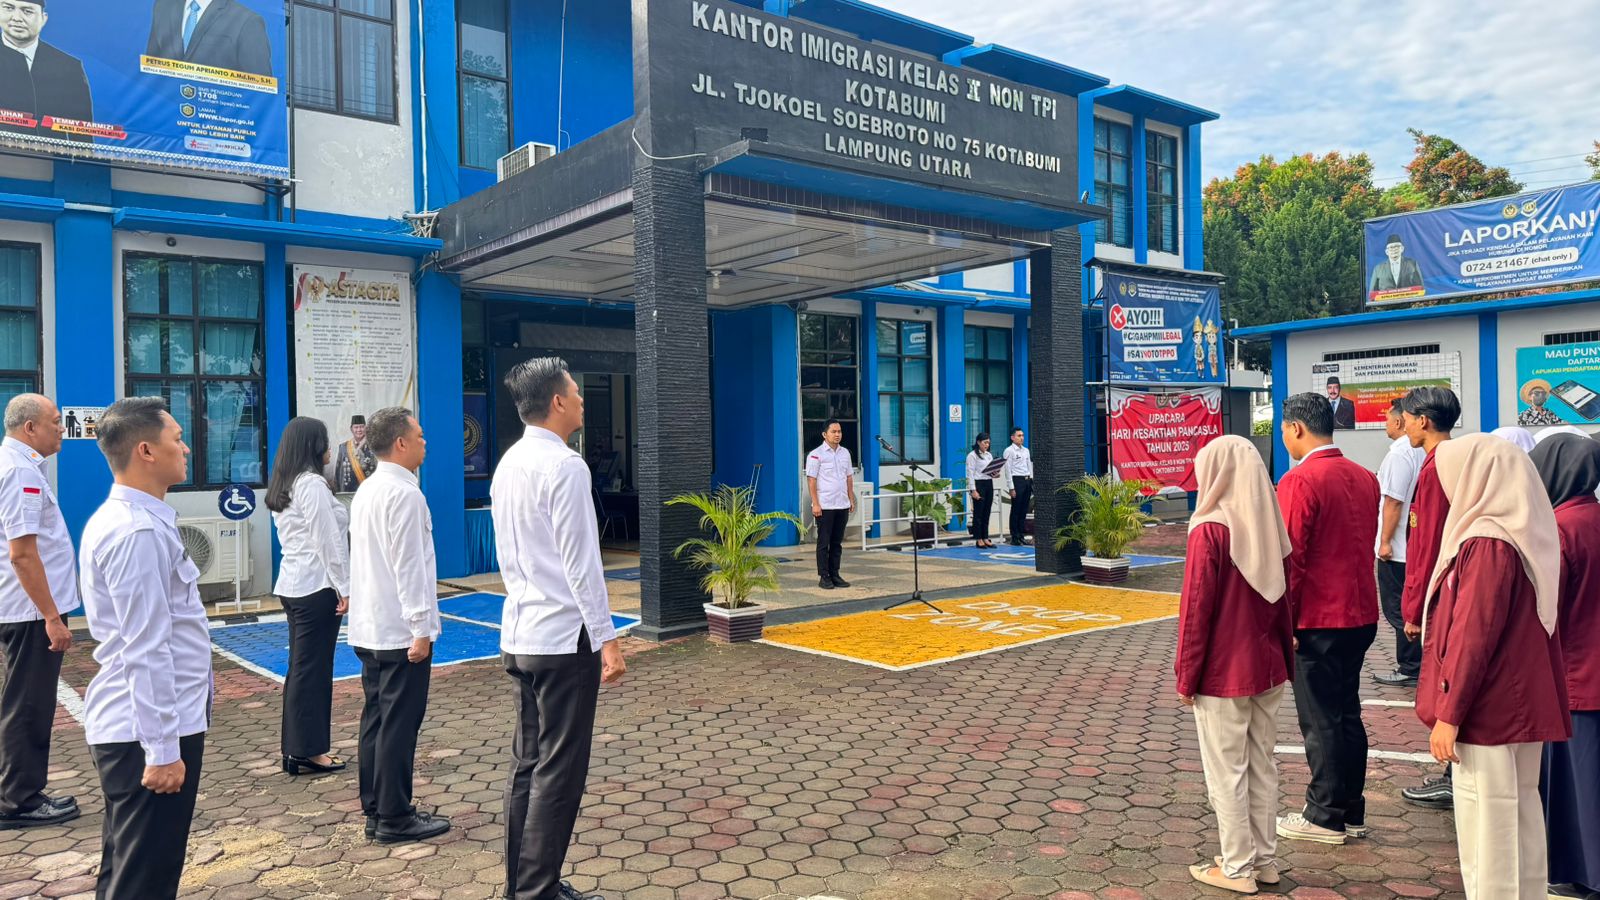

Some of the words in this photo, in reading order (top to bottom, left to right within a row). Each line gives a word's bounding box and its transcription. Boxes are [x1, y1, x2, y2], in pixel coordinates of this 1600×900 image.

[146, 58, 170, 66] PETRUS
[172, 62, 194, 71] TEGUH
[196, 65, 229, 76] APRIANTO
[692, 1, 794, 54] KANTOR
[801, 32, 894, 80] IMIGRASI
[899, 60, 959, 97] KELAS
[989, 83, 1024, 112] NON
[1030, 94, 1057, 120] TPI
[198, 92, 218, 100] 1708
[844, 79, 946, 124] KOTABUMI
[52, 117, 80, 126] TEMMY
[82, 121, 114, 130] TARMIZI
[202, 124, 232, 133] LAYANAN
[234, 128, 256, 136] PUBLIK
[691, 74, 726, 100] JL.
[734, 82, 827, 123] TJOKOEL
[832, 107, 929, 145] SOEBROTO
[933, 131, 956, 152] NO
[962, 138, 981, 156] 75
[984, 144, 1061, 174] KOTABUMI
[210, 130, 228, 138] LEBIH
[824, 133, 912, 168] LAMPUNG
[919, 154, 972, 179] UTARA
[1444, 210, 1596, 248] LAPORKAN!
[1461, 247, 1486, 255] TERJADI
[1486, 243, 1514, 253] KENDALA
[1516, 240, 1537, 249] DALAM
[1539, 234, 1576, 244] PELAYANAN
[1524, 244, 1548, 252] NOMOR
[1466, 262, 1492, 272] 0724
[1496, 257, 1530, 269] 21467
[1552, 254, 1568, 262] only
[1518, 270, 1540, 278] UNTUK
[1540, 264, 1583, 275] MEMBERIKAN
[1476, 280, 1512, 288] PELAYANAN
[1126, 310, 1160, 325] AYO!!!
[1545, 349, 1570, 358] MAU
[1568, 357, 1600, 365] DAFTAR
[1148, 412, 1186, 424] UPACARA
[1111, 428, 1131, 440] HARI
[1132, 427, 1177, 439] KESAKTIAN
[1146, 442, 1172, 454] TAHUN
[1174, 440, 1190, 452] 2025
[958, 600, 1122, 622] DROP
[888, 609, 1057, 637] ZONE
